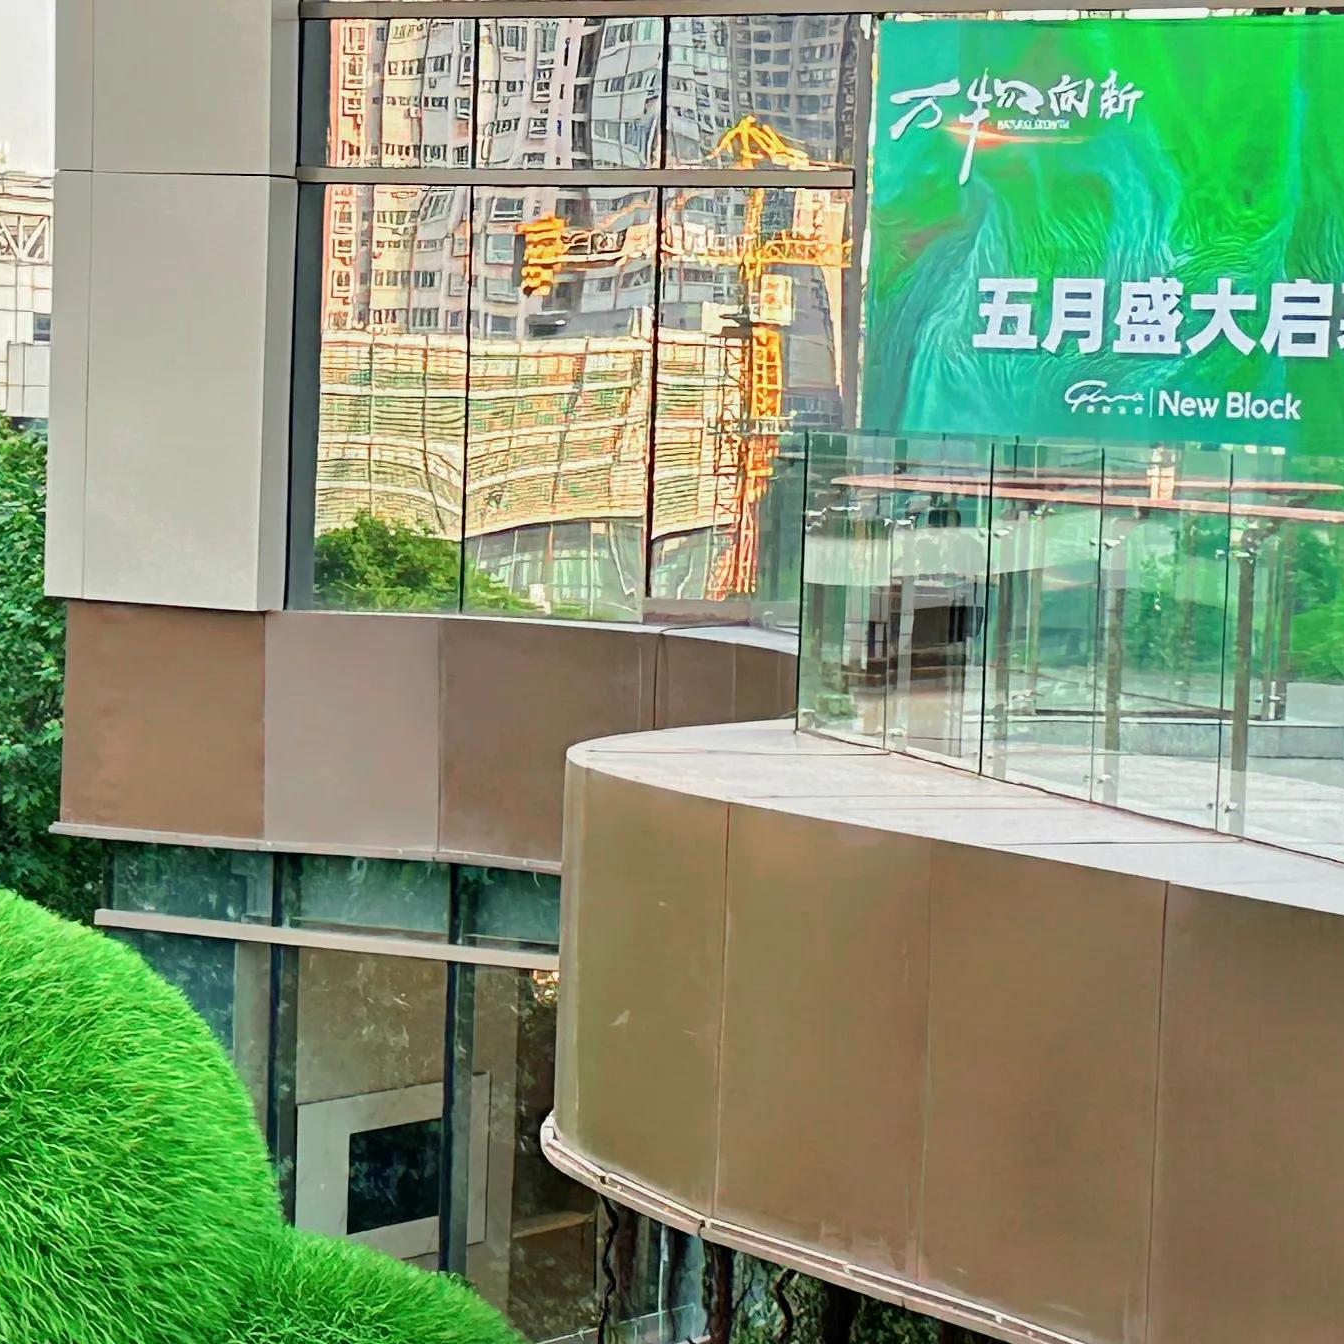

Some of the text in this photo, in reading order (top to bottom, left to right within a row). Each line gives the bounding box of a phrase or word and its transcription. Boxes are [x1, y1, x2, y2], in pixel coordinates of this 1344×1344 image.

[889, 67, 1144, 186] 万物向新
[1158, 390, 1220, 417] New
[1225, 391, 1302, 420] Block
